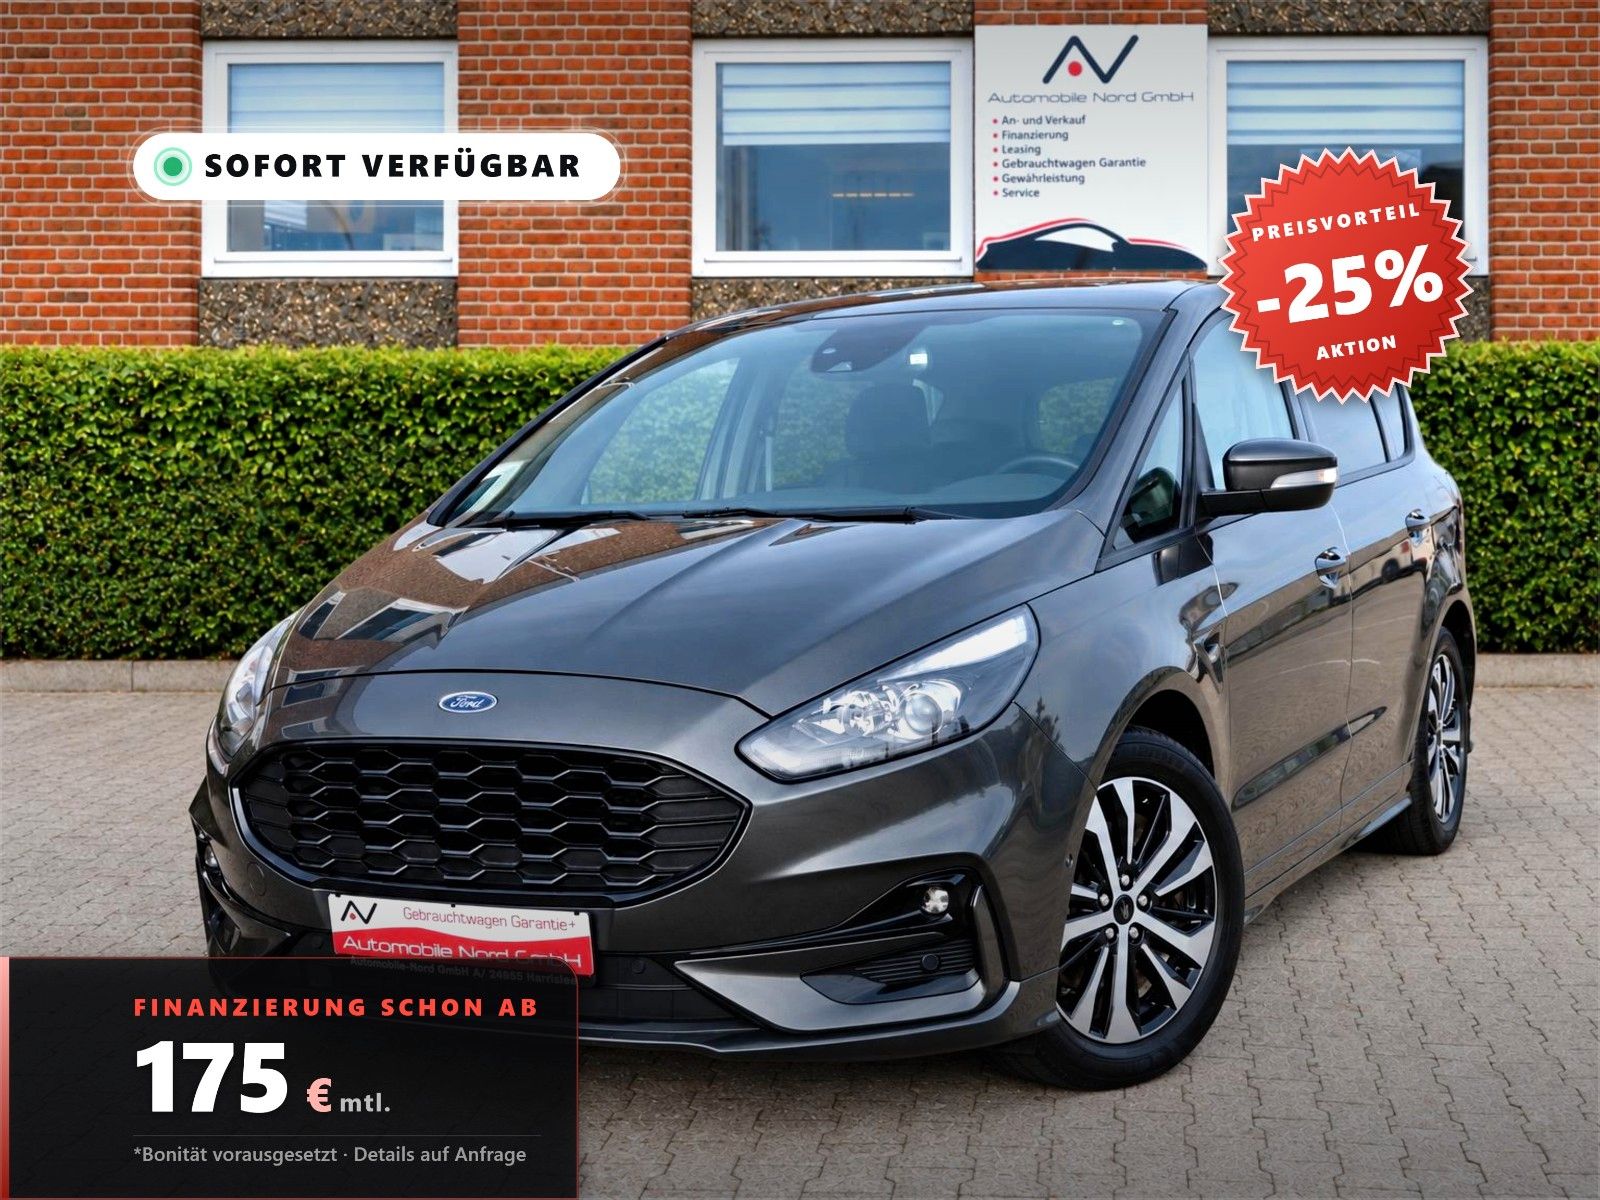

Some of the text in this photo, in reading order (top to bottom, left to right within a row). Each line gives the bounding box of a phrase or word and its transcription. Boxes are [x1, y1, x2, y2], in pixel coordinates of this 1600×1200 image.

[988, 91, 1194, 103] Automobile Nord GmbH
[1002, 115, 1086, 125] An- und Verkauf
[1002, 130, 1069, 142] Finanzierung
[1002, 144, 1041, 156] Leasing
[1002, 157, 1146, 171] Gebrauchtwagen Garantie
[1002, 173, 1085, 185] Gewährleistung
[1002, 188, 1040, 197] Service
[450, 695, 485, 708] Ford
[403, 907, 507, 928] Gebrauchtwagen
[343, 935, 453, 959] Automobile
[459, 945, 511, 960] Nord
